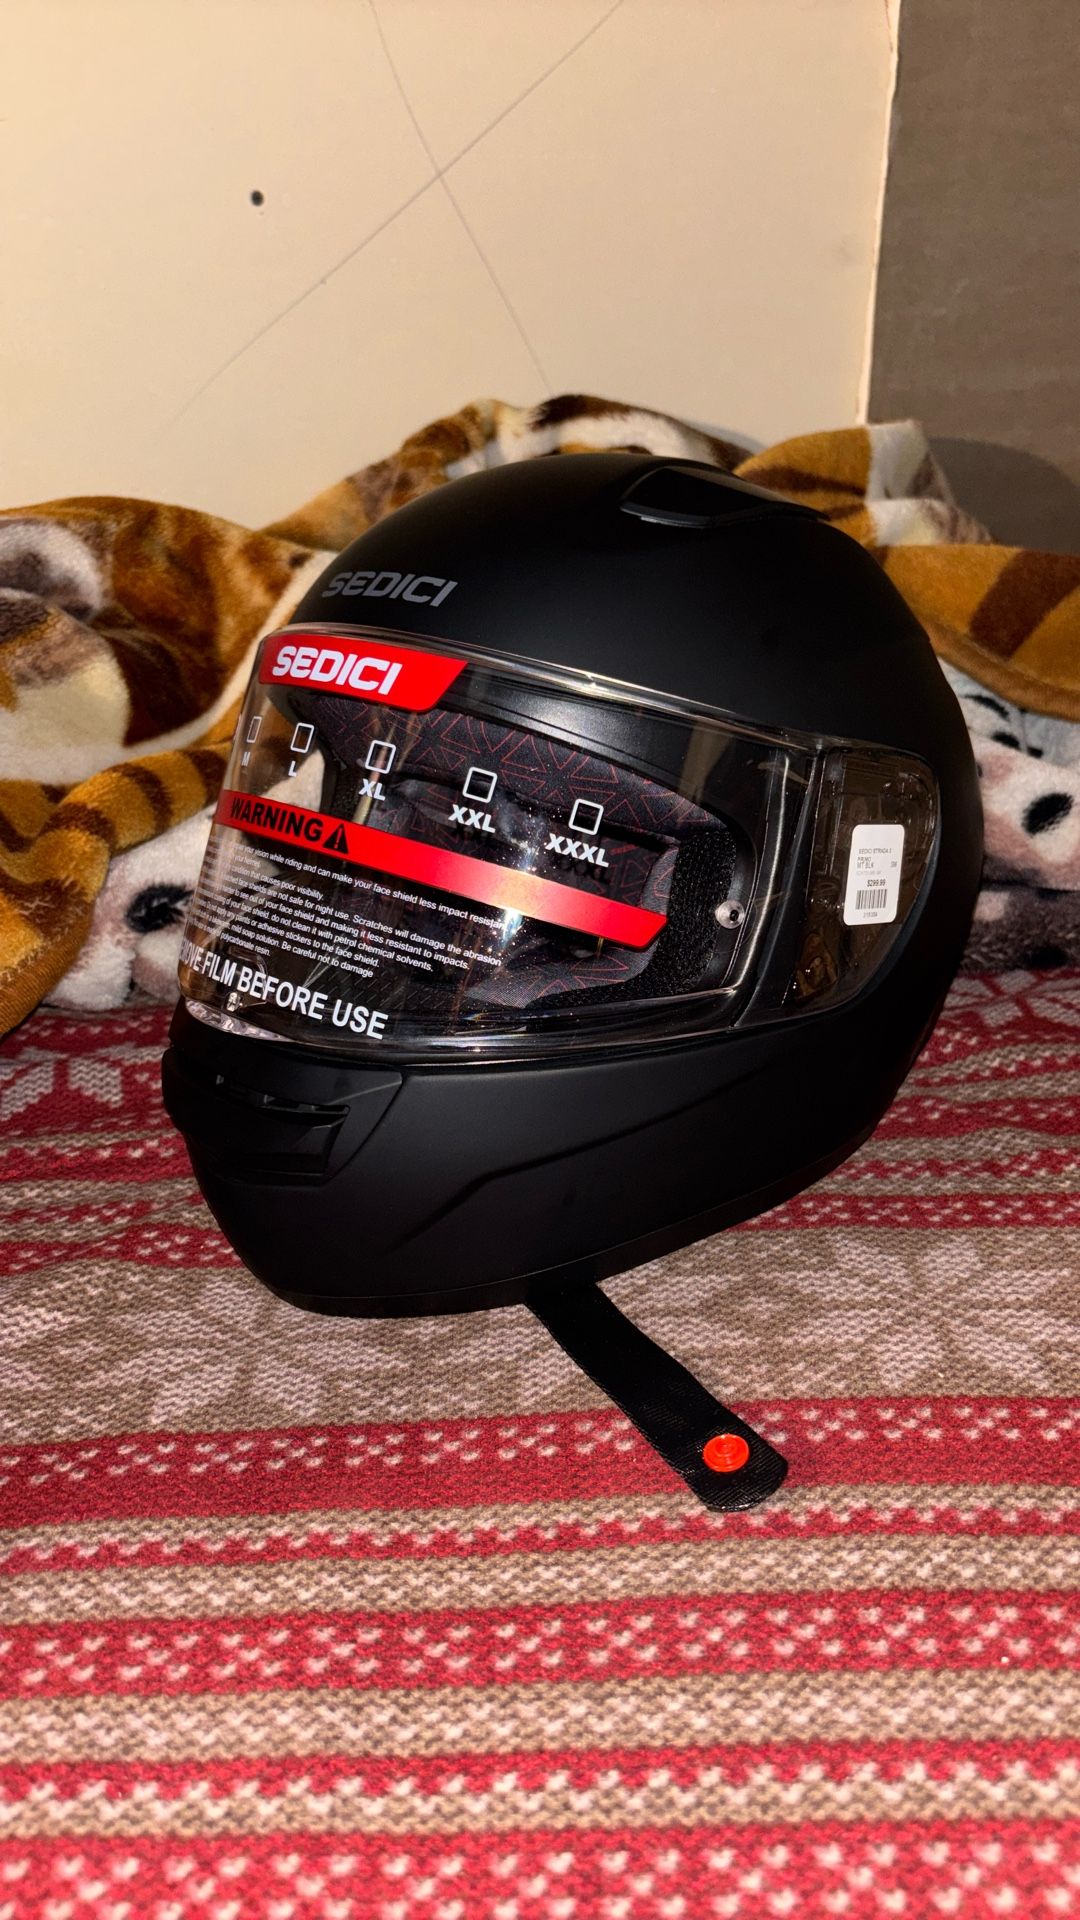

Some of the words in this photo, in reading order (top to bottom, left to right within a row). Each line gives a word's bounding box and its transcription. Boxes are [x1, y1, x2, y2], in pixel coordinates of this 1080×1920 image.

[322, 571, 458, 607] SEDICI
[272, 646, 403, 695] SEDICI
[231, 797, 324, 842] WARNING
[241, 751, 251, 767] M
[288, 761, 297, 777] L
[358, 778, 386, 801] XL
[448, 804, 496, 833] XXL
[545, 833, 609, 868] XXXL
[261, 875, 280, 886] causes
[281, 882, 296, 892] poor
[297, 886, 324, 900] visibility.
[270, 853, 284, 863] while
[285, 858, 302, 870] riding
[303, 864, 316, 873] and
[317, 868, 330, 877] can
[332, 872, 353, 884] make
[354, 879, 372, 889] your
[373, 883, 391, 895] face
[393, 890, 418, 903] shield
[419, 897, 436, 909] less
[438, 903, 468, 919] impact
[866, 879, 886, 888] $299.99
[220, 932, 255, 951] polycarbonate
[255, 946, 270, 956] resin.
[241, 903, 252, 912] face
[271, 914, 280, 922] do
[280, 917, 291, 926] not
[292, 921, 311, 932] clean
[312, 927, 317, 935] it
[318, 930, 333, 940] with
[334, 934, 357, 947] petrol
[358, 941, 395, 959] chemical
[396, 954, 434, 972] solvents.
[249, 883, 267, 893] shields
[267, 889, 277, 897] are
[278, 893, 288, 901] not
[289, 895, 304, 906] safe
[304, 899, 315, 909] for
[315, 903, 334, 915] night
[334, 910, 351, 921] use.
[352, 914, 393, 934] Scratches
[395, 928, 409, 939] will
[410, 933, 446, 950] damage
[447, 943, 462, 955] the
[463, 949, 502, 967] abrasion
[249, 895, 258, 903] out
[265, 900, 278, 909] your
[279, 904, 293, 914] face
[294, 909, 315, 921] shield
[315, 916, 329, 926] and
[330, 922, 359, 938] making
[360, 930, 366, 938] it
[367, 932, 384, 943] less
[385, 938, 422, 955] resistant
[424, 949, 432, 958] to
[434, 952, 470, 970] impacts.
[257, 922, 285, 936] adhesive
[285, 933, 311, 945] stickers
[322, 943, 334, 953] the
[335, 946, 352, 958] face
[354, 953, 379, 967] shield.
[242, 929, 255, 939] soap
[256, 933, 280, 947] solution.
[281, 941, 291, 951] Be
[292, 946, 317, 960] careful
[317, 954, 330, 964] not
[331, 959, 339, 967] to
[341, 962, 373, 978] damage
[180, 937, 204, 971] MOVE
[201, 951, 237, 987] FILM
[237, 966, 328, 1020] BEFORE
[331, 999, 389, 1040] USE
